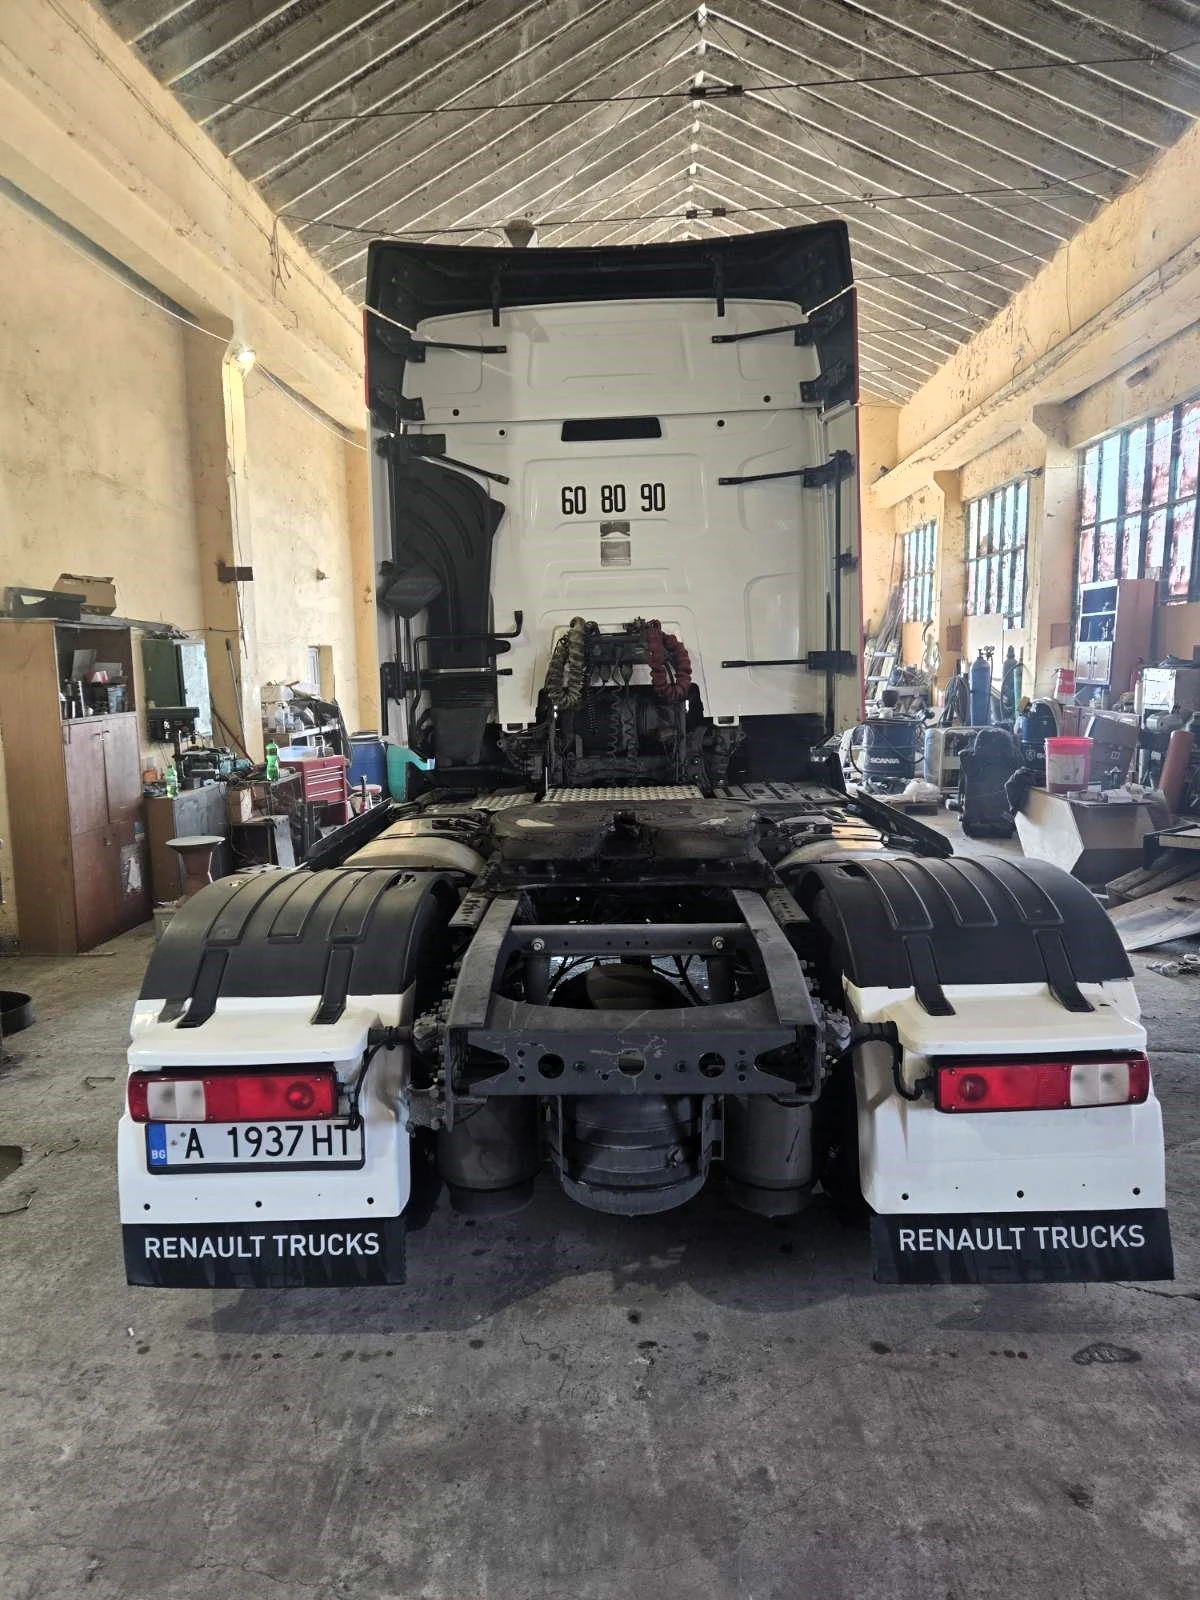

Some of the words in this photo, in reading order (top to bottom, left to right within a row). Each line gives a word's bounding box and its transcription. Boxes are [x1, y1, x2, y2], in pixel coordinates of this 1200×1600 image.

[561, 486, 587, 515] 60
[600, 484, 626, 513] 80
[640, 482, 666, 512] 90
[151, 1150, 166, 1160] BG
[185, 1127, 204, 1159] A
[226, 1125, 304, 1158] 1937
[311, 1124, 355, 1156] HT
[144, 1235, 266, 1260] RENAULT
[272, 1232, 380, 1257] TRUCKS
[898, 1226, 1026, 1252] RENAULT
[1032, 1224, 1146, 1250] TRUCKS
